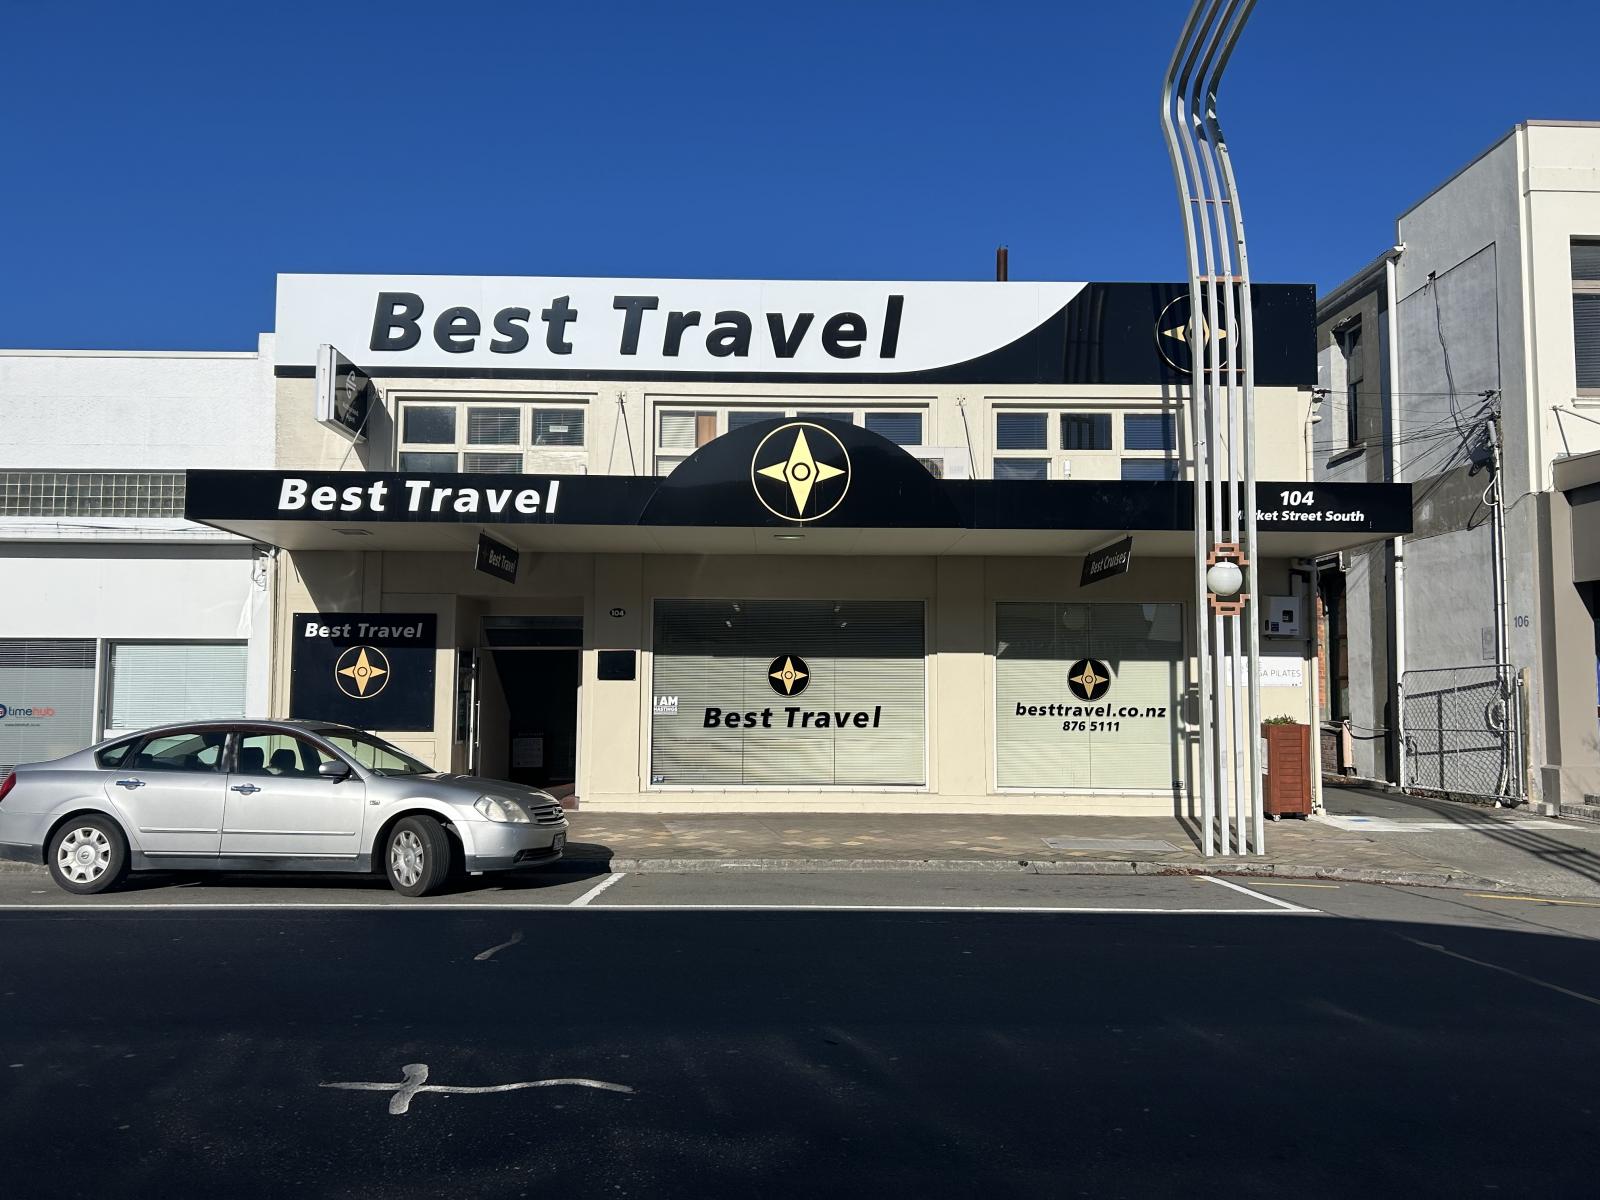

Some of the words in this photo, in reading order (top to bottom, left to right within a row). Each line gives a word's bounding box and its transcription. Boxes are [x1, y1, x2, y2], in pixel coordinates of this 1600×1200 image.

[370, 292, 578, 355] Best
[613, 295, 905, 359] Travel
[277, 478, 388, 513] Best
[405, 480, 560, 515] Travel
[1280, 491, 1315, 506] 104
[1281, 511, 1322, 521] Street
[1325, 511, 1365, 522] South
[1090, 558, 1104, 575] Best
[1104, 552, 1127, 570] Cruises
[611, 609, 625, 617] 104
[1514, 615, 1529, 628] 106
[304, 622, 351, 638] Best
[358, 622, 424, 638] Travel
[1270, 669, 1302, 677] PILATES
[660, 696, 679, 705] AM
[8, 706, 55, 717] timehub
[1015, 702, 1166, 718] besttravel.co.nz
[703, 708, 773, 728] Best
[785, 706, 882, 729] Travel
[1062, 721, 1086, 731] 876
[1090, 722, 1120, 732] 5111
